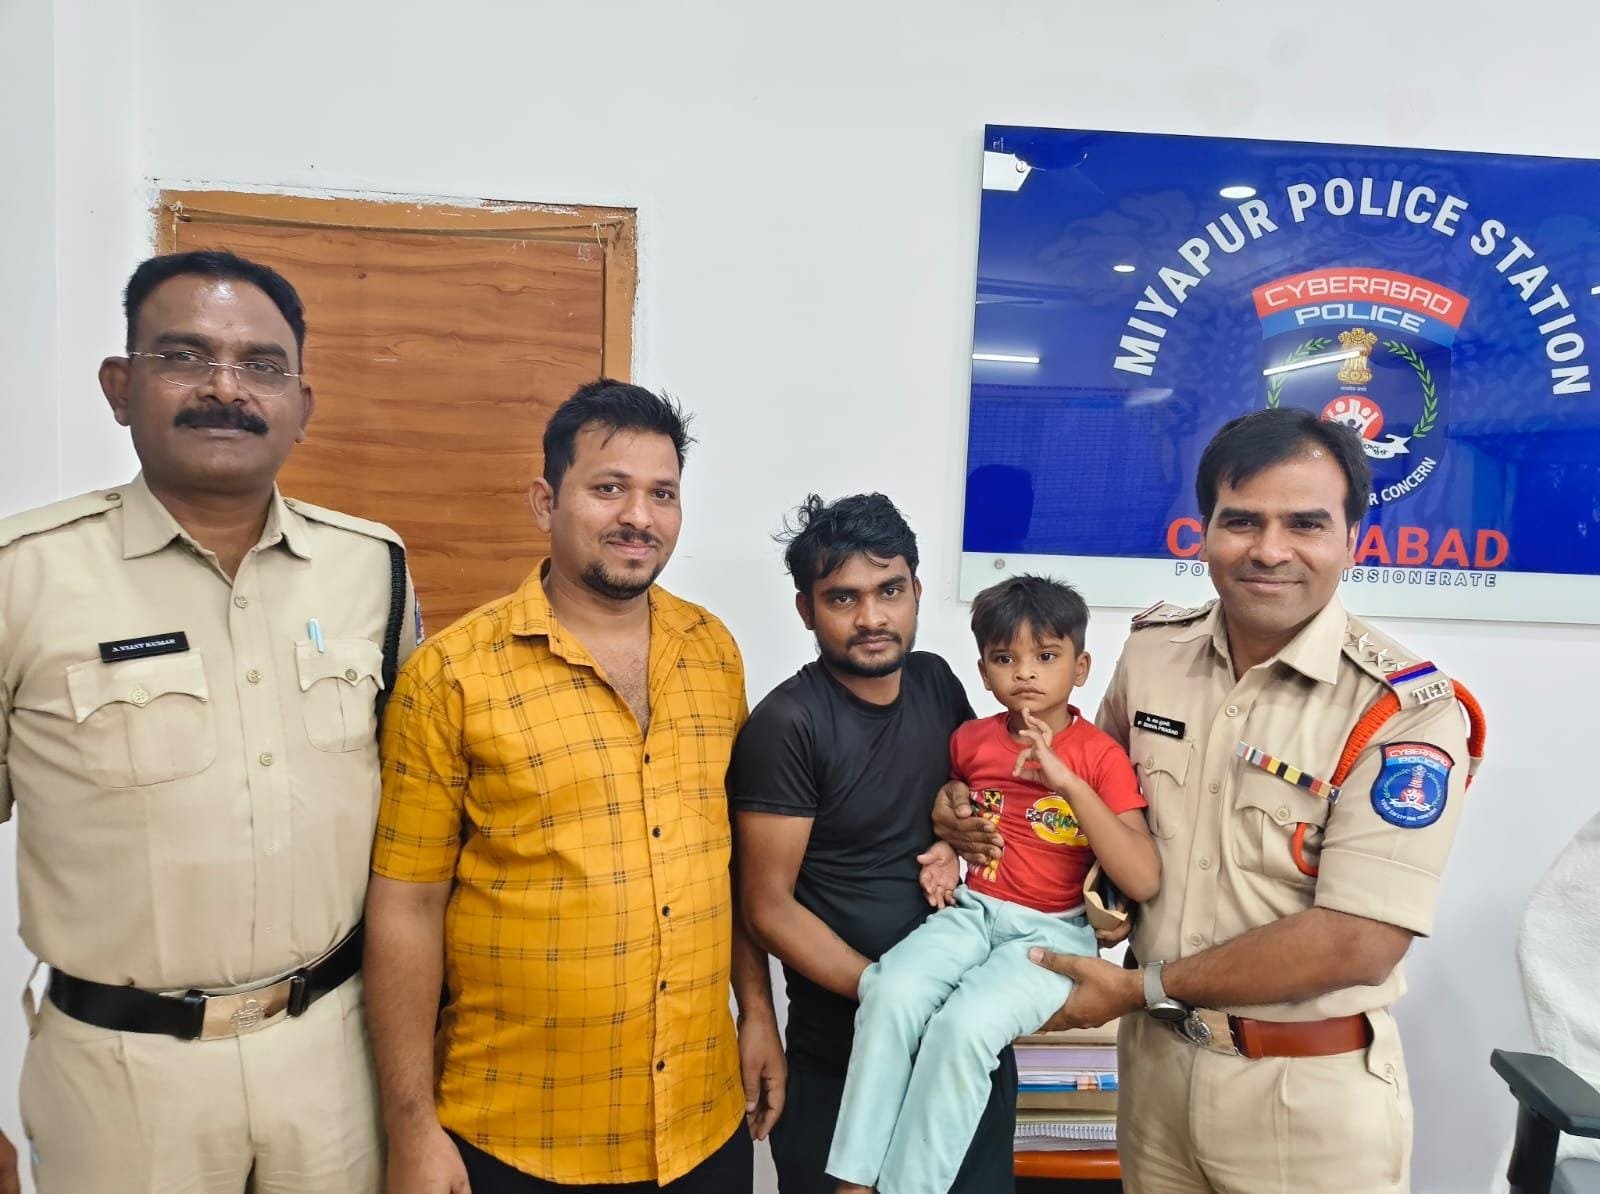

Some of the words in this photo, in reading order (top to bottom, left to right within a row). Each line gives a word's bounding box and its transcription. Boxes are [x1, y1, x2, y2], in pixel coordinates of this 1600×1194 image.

[1113, 199, 1279, 376] MIYAPUR
[1287, 177, 1469, 236] POLICE
[1470, 218, 1591, 395] STATION
[1264, 276, 1453, 315] CYBERABAD
[1294, 303, 1426, 333] POLICE
[1380, 456, 1437, 502] CONCERN
[1341, 568, 1497, 587] ISSIONERATE
[1389, 748, 1449, 767] CYBERABAD
[1398, 756, 1443, 770] POLICE
